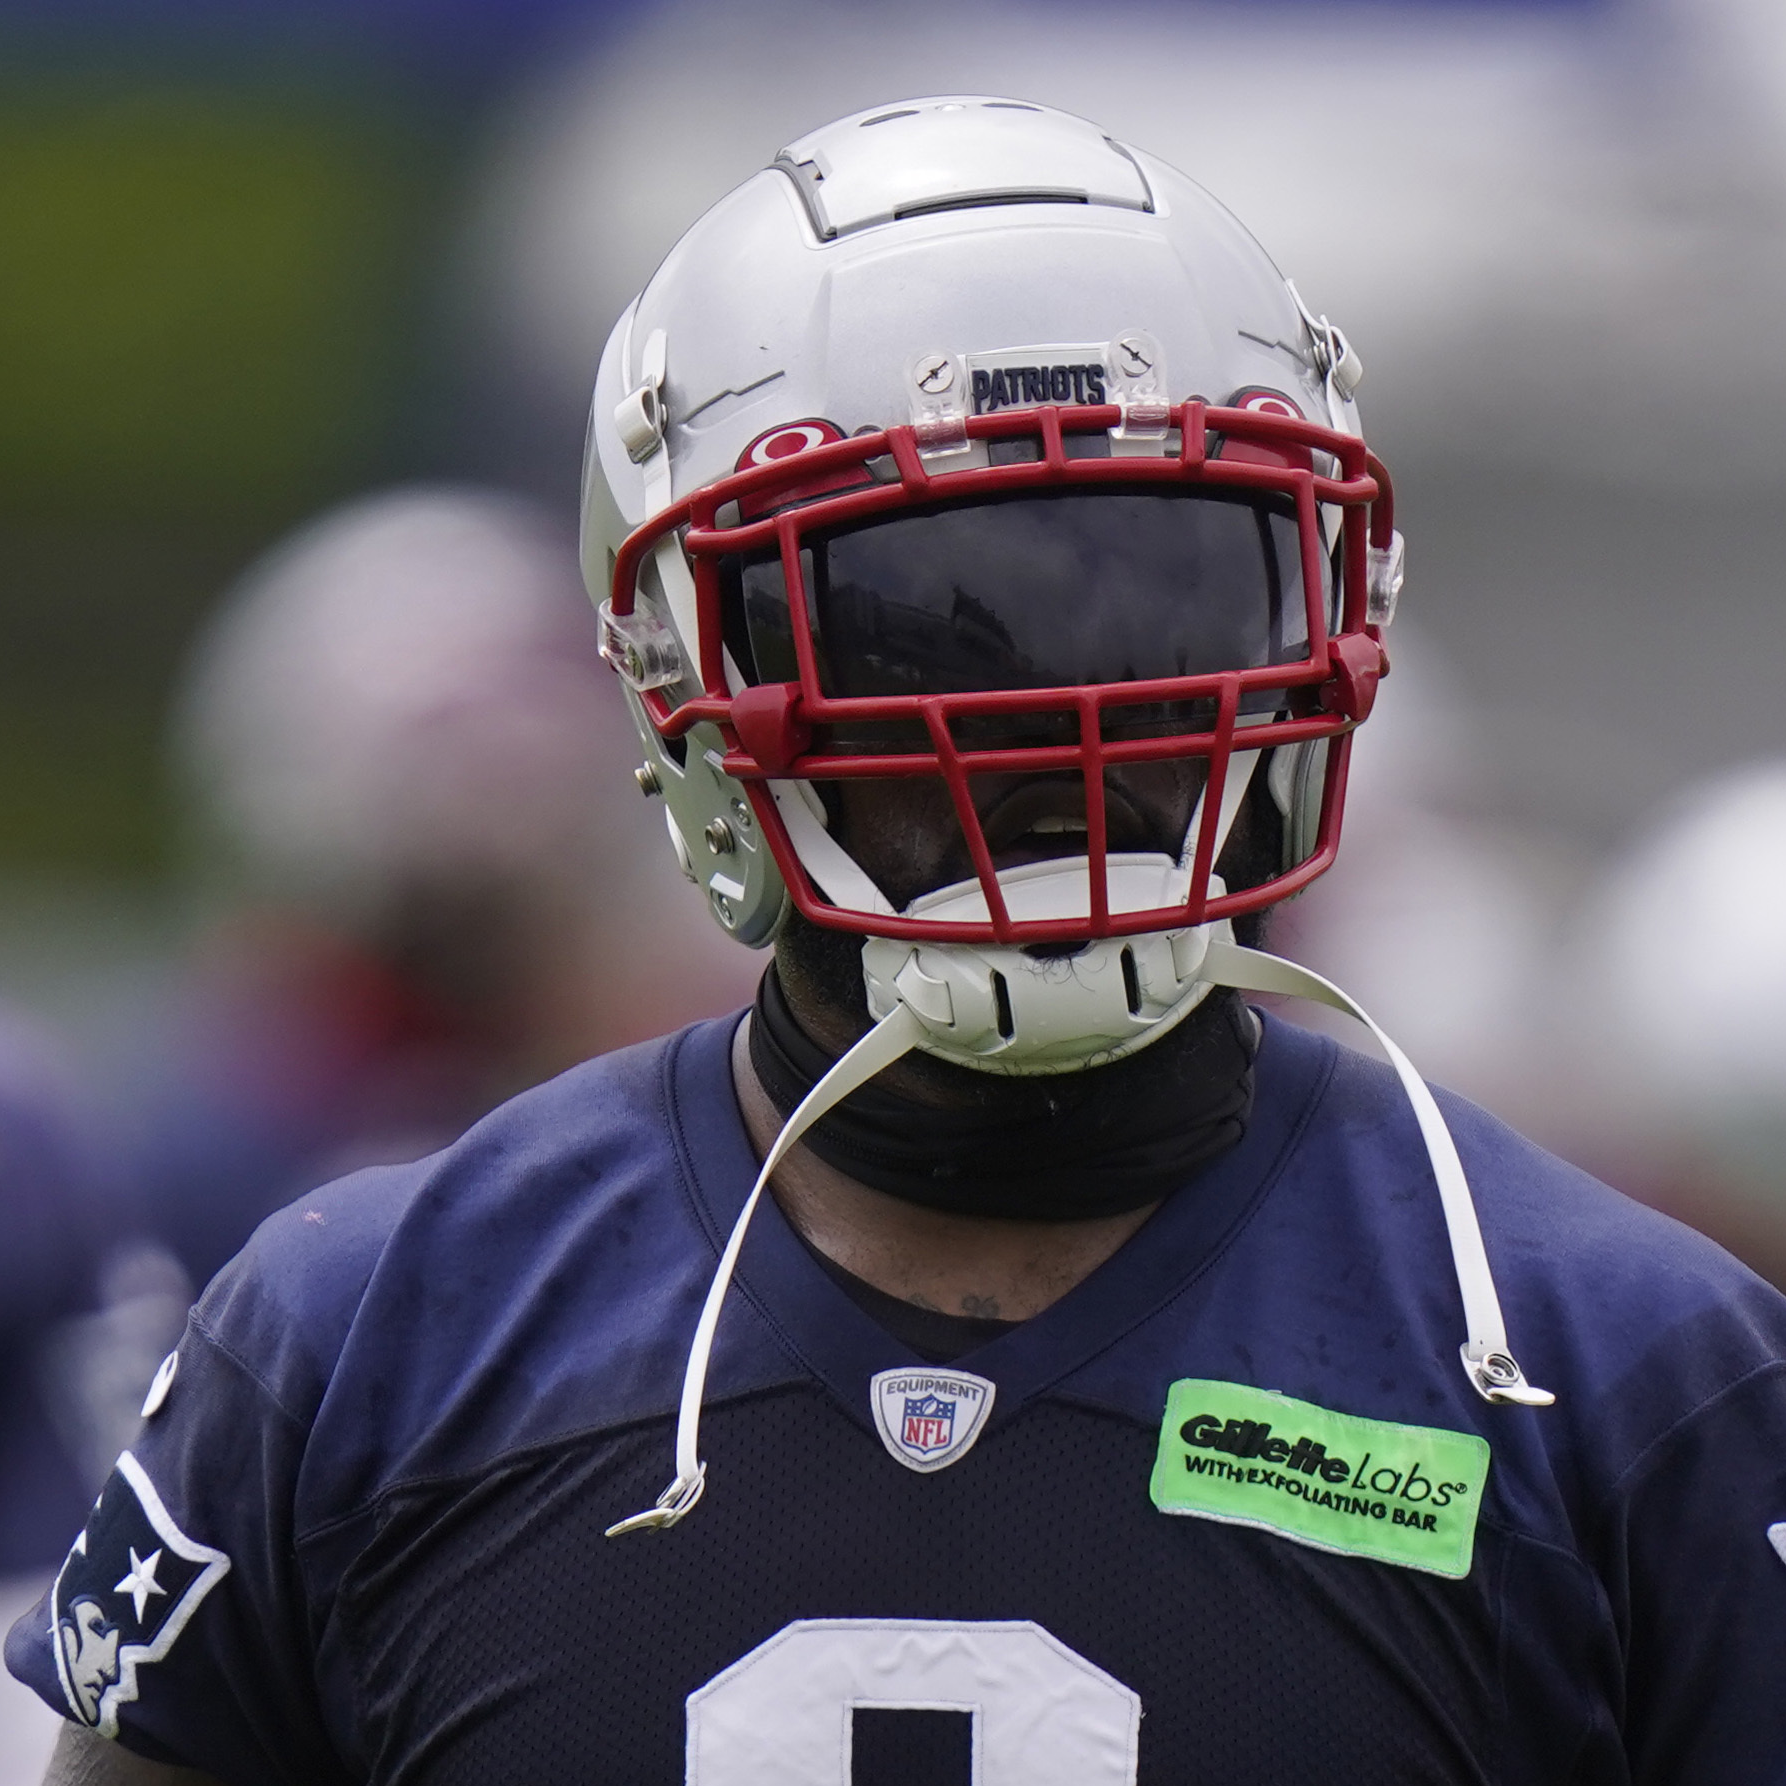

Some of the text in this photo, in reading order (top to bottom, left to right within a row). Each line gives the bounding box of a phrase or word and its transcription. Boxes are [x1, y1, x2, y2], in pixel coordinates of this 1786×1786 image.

[971, 363, 1106, 415] PATRIOTS
[886, 1378, 980, 1401] EQUIPMENT
[904, 1416, 948, 1448] NFL
[1184, 1454, 1438, 1533] WITH EXFOLIATING BAR
